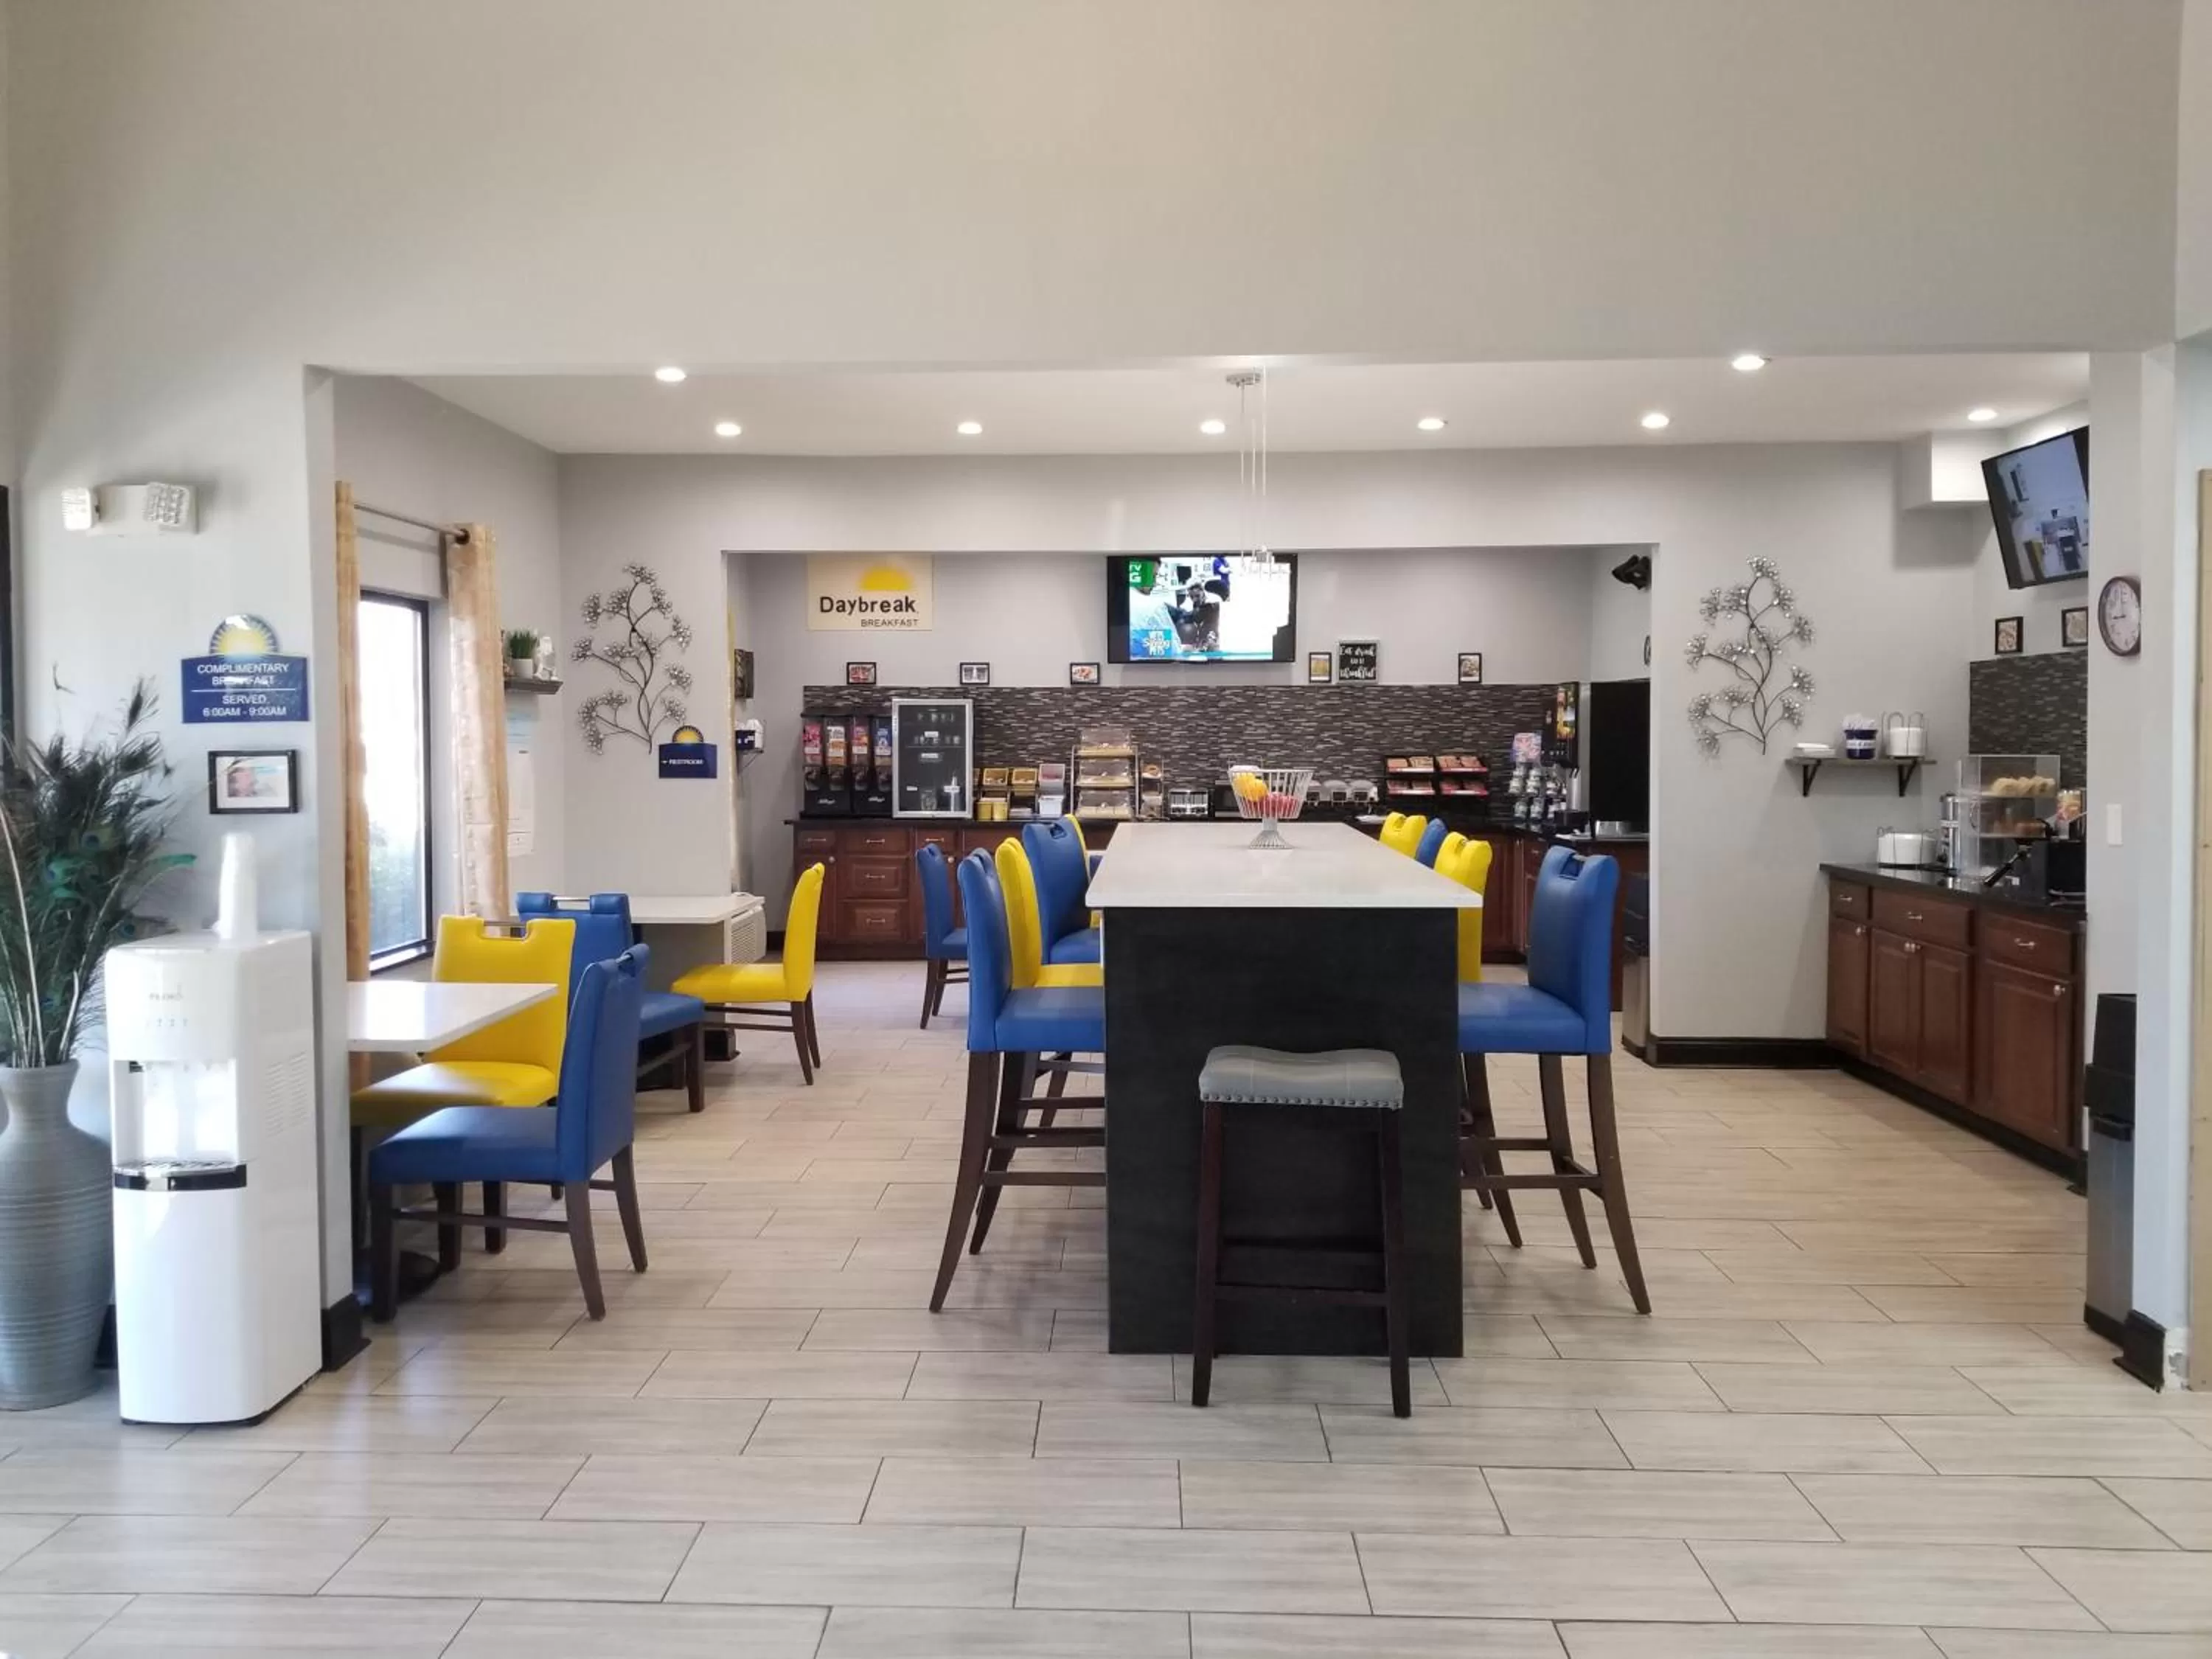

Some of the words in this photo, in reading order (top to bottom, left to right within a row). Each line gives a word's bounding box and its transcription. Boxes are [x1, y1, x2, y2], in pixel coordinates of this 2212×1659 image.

[819, 596, 917, 616] Daybreak
[860, 619, 919, 627] BREAKFAST
[197, 663, 289, 674] COMPLIMENTARY
[212, 675, 275, 686] BRFAST
[222, 694, 267, 705] SERVED
[202, 706, 242, 717] 6:00AM
[248, 706, 288, 717] 9:00AM
